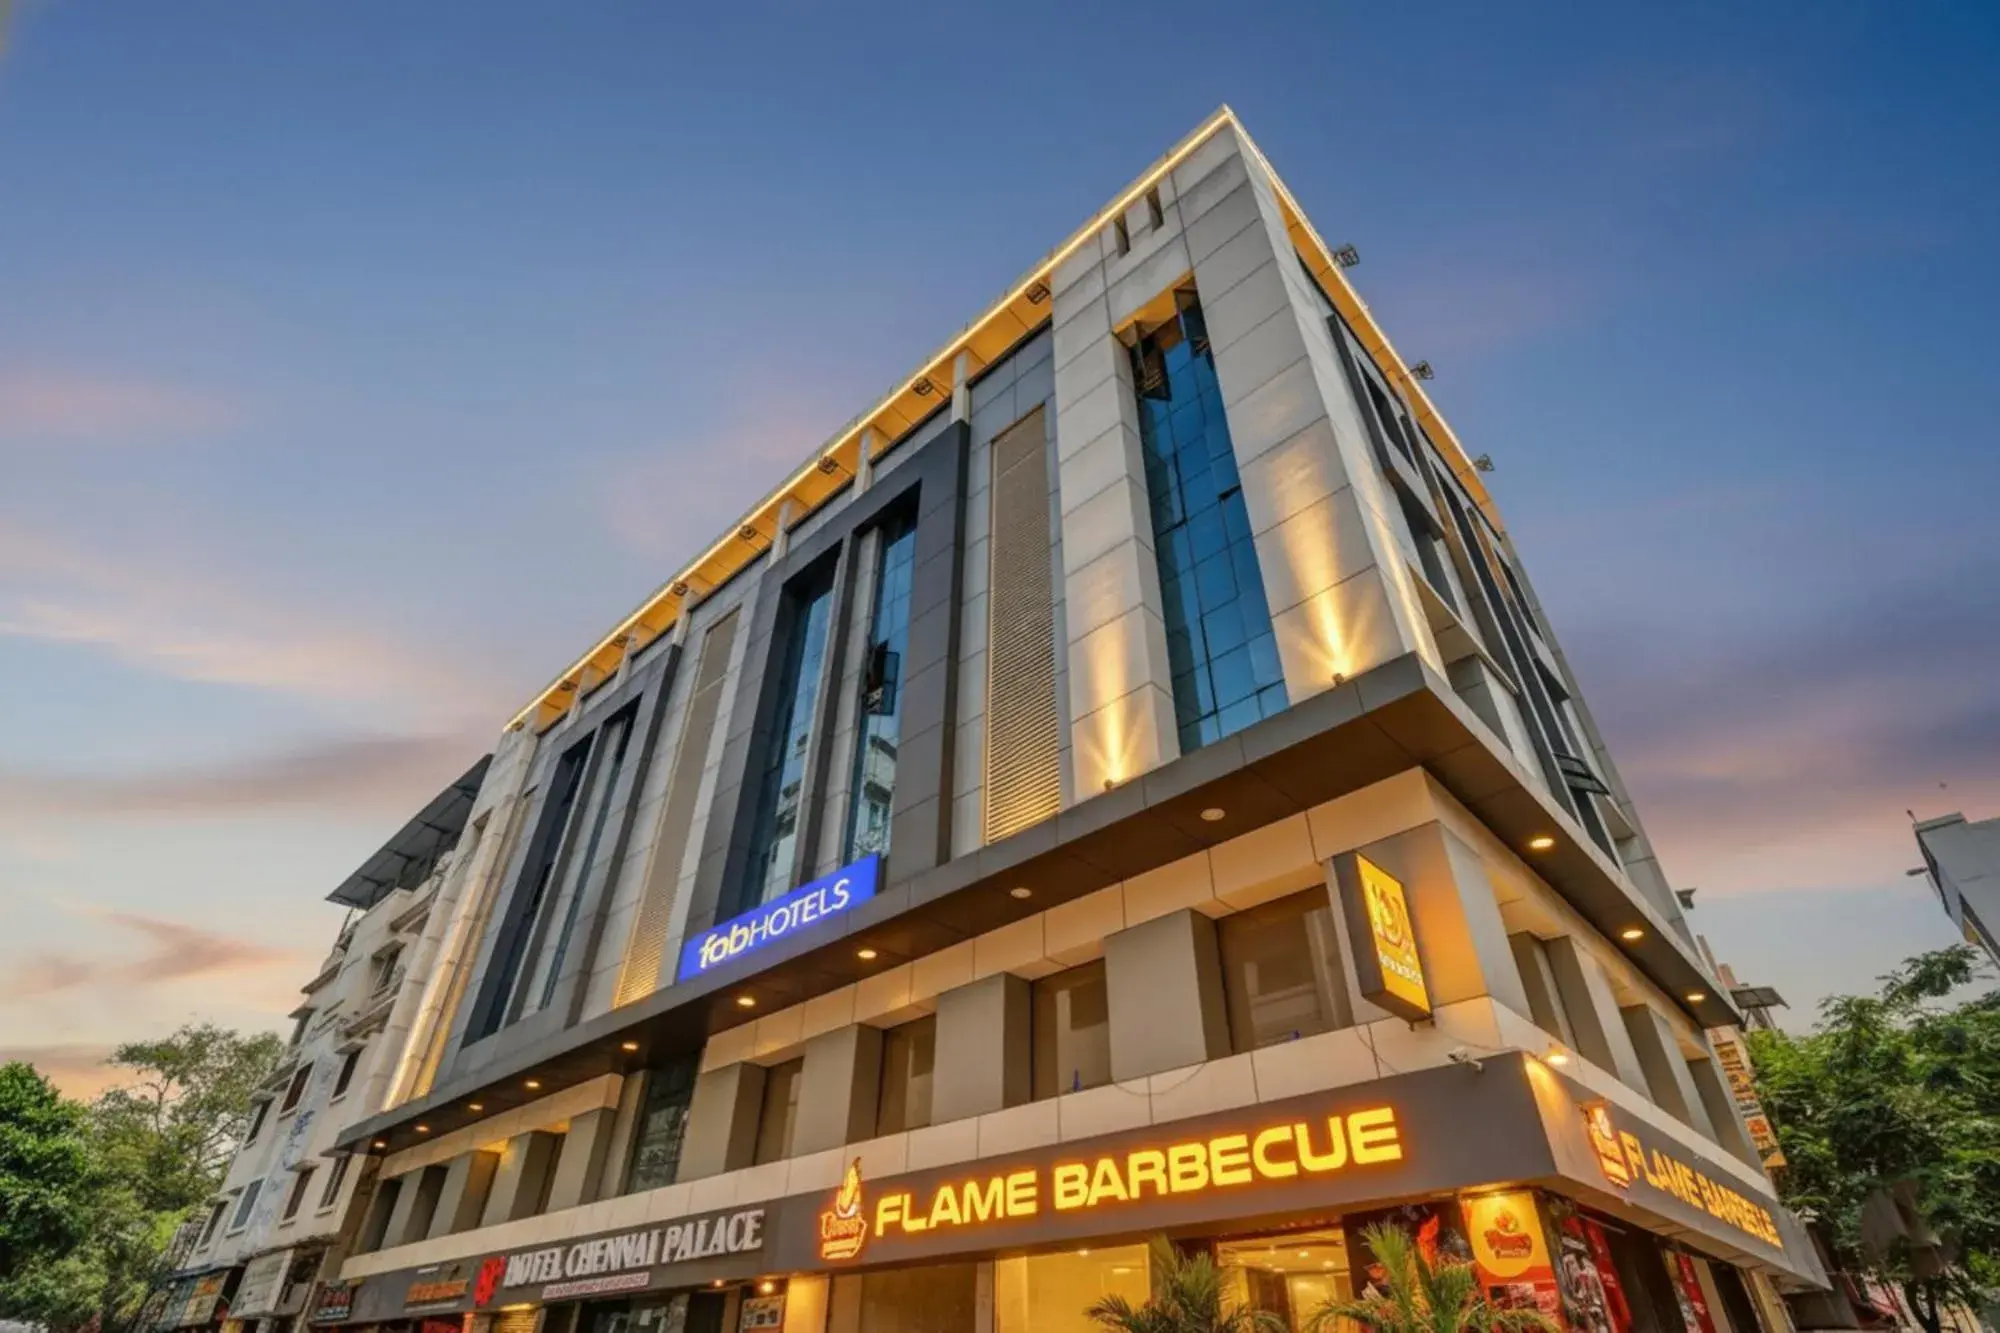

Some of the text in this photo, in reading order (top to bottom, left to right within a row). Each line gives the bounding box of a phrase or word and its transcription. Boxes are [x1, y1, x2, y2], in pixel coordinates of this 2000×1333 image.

[700, 878, 850, 969] fabHOTELS
[875, 1106, 1402, 1236] FLAME BARBECUE
[1619, 1130, 1704, 1209] FLAME
[503, 1248, 565, 1288] HOTEL
[565, 1230, 661, 1278] CHENNAI
[661, 1209, 765, 1264] PALACE
